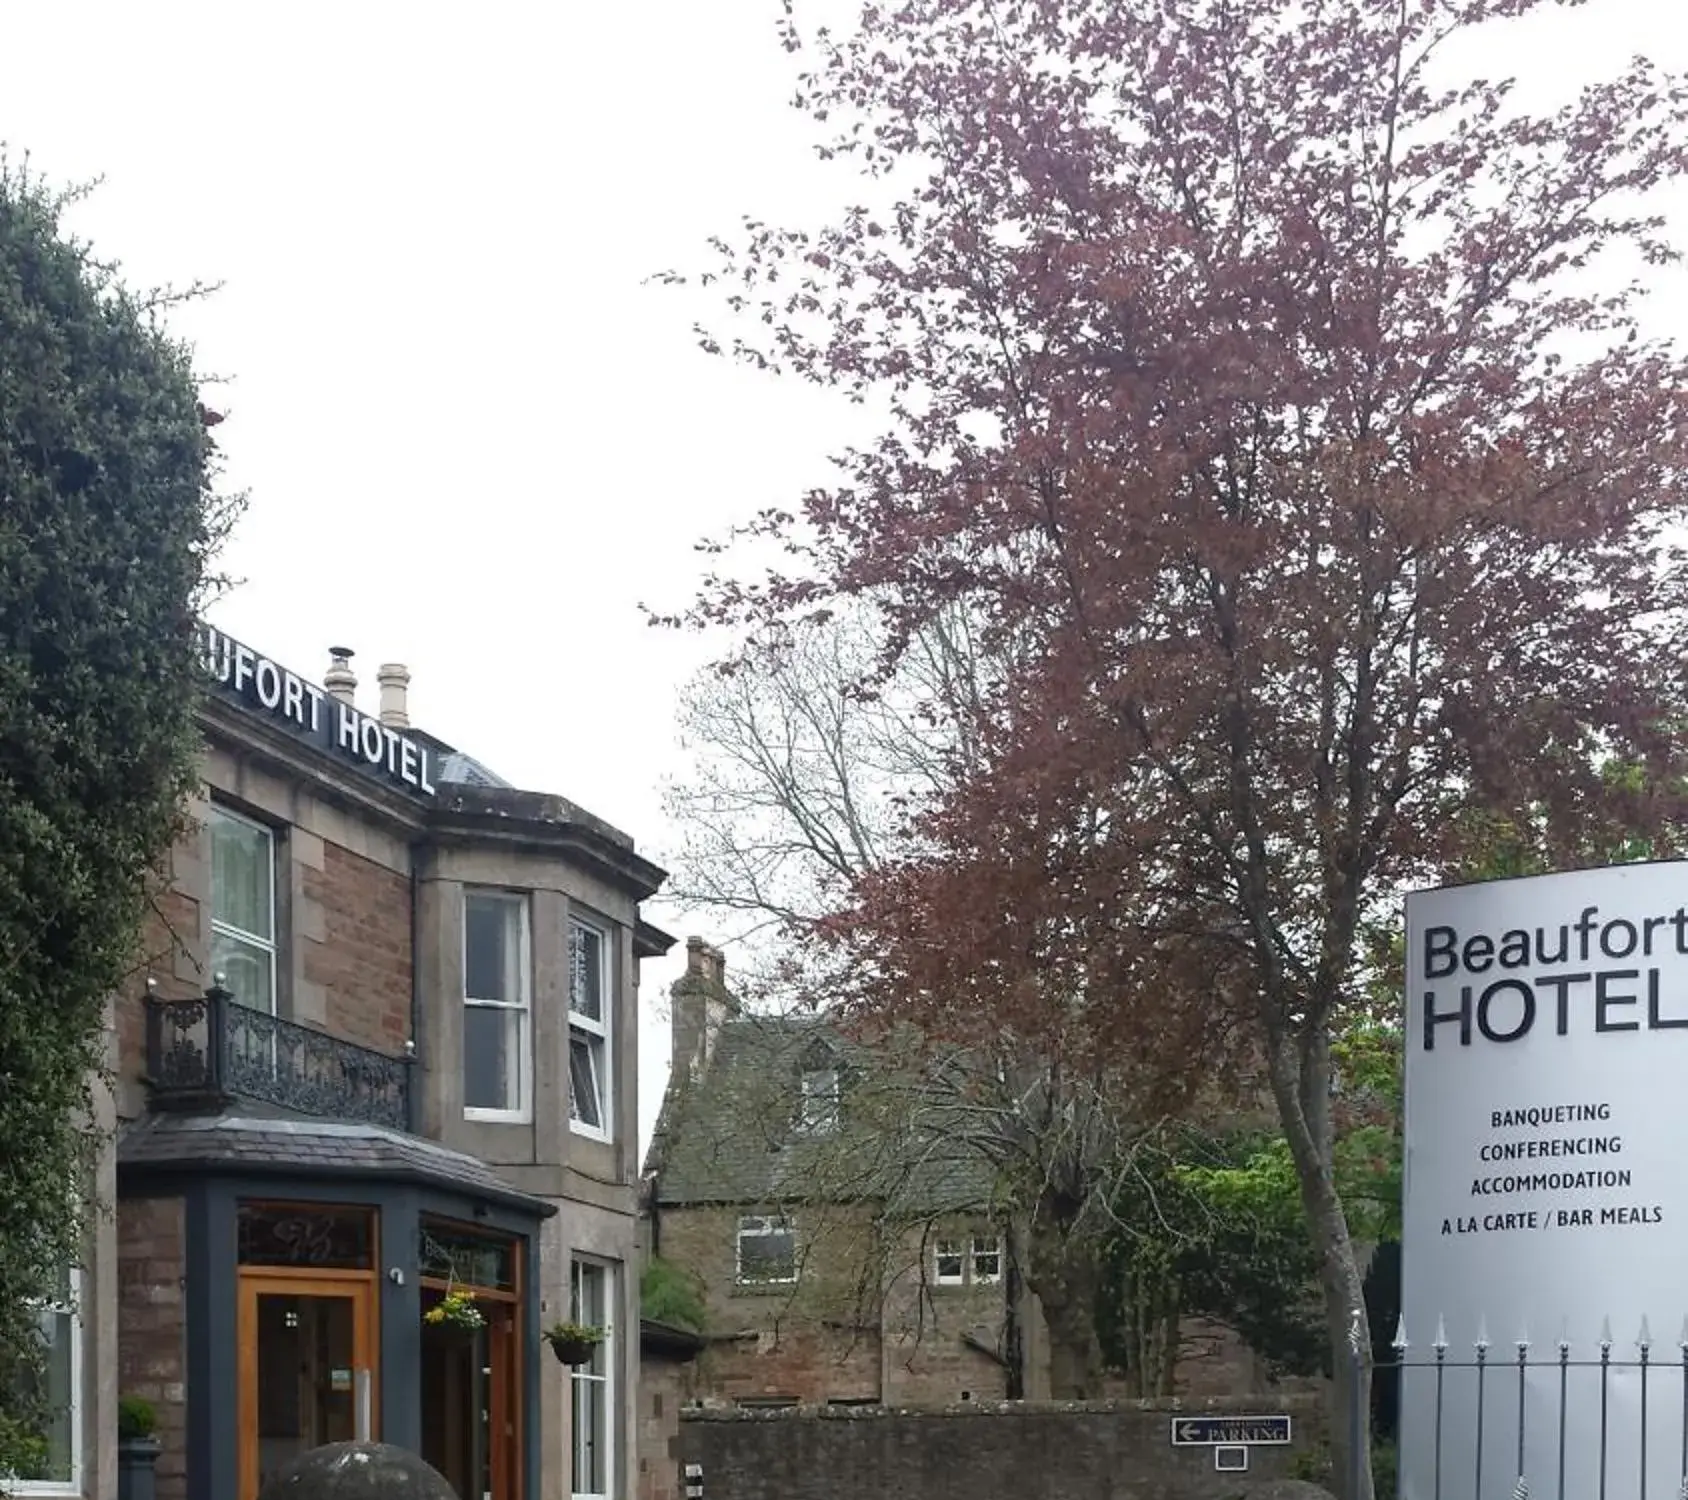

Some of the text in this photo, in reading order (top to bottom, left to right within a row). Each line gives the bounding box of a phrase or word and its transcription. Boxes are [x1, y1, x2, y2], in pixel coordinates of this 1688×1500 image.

[197, 627, 435, 796] UFORT HOTEL
[1424, 906, 1688, 980] Beaufort
[1423, 968, 1688, 1050] HOTEL
[1491, 1103, 1611, 1128] BANQUETING
[1480, 1136, 1621, 1161] CONFERENCING
[1471, 1170, 1631, 1196] ACCOMMODATION
[1441, 1219, 1452, 1235] A
[1456, 1216, 1478, 1233] LA
[1483, 1211, 1538, 1231] CARTE
[1557, 1209, 1593, 1227] BAR
[1601, 1206, 1662, 1225] MEALS
[1207, 1428, 1285, 1441] PARKING
